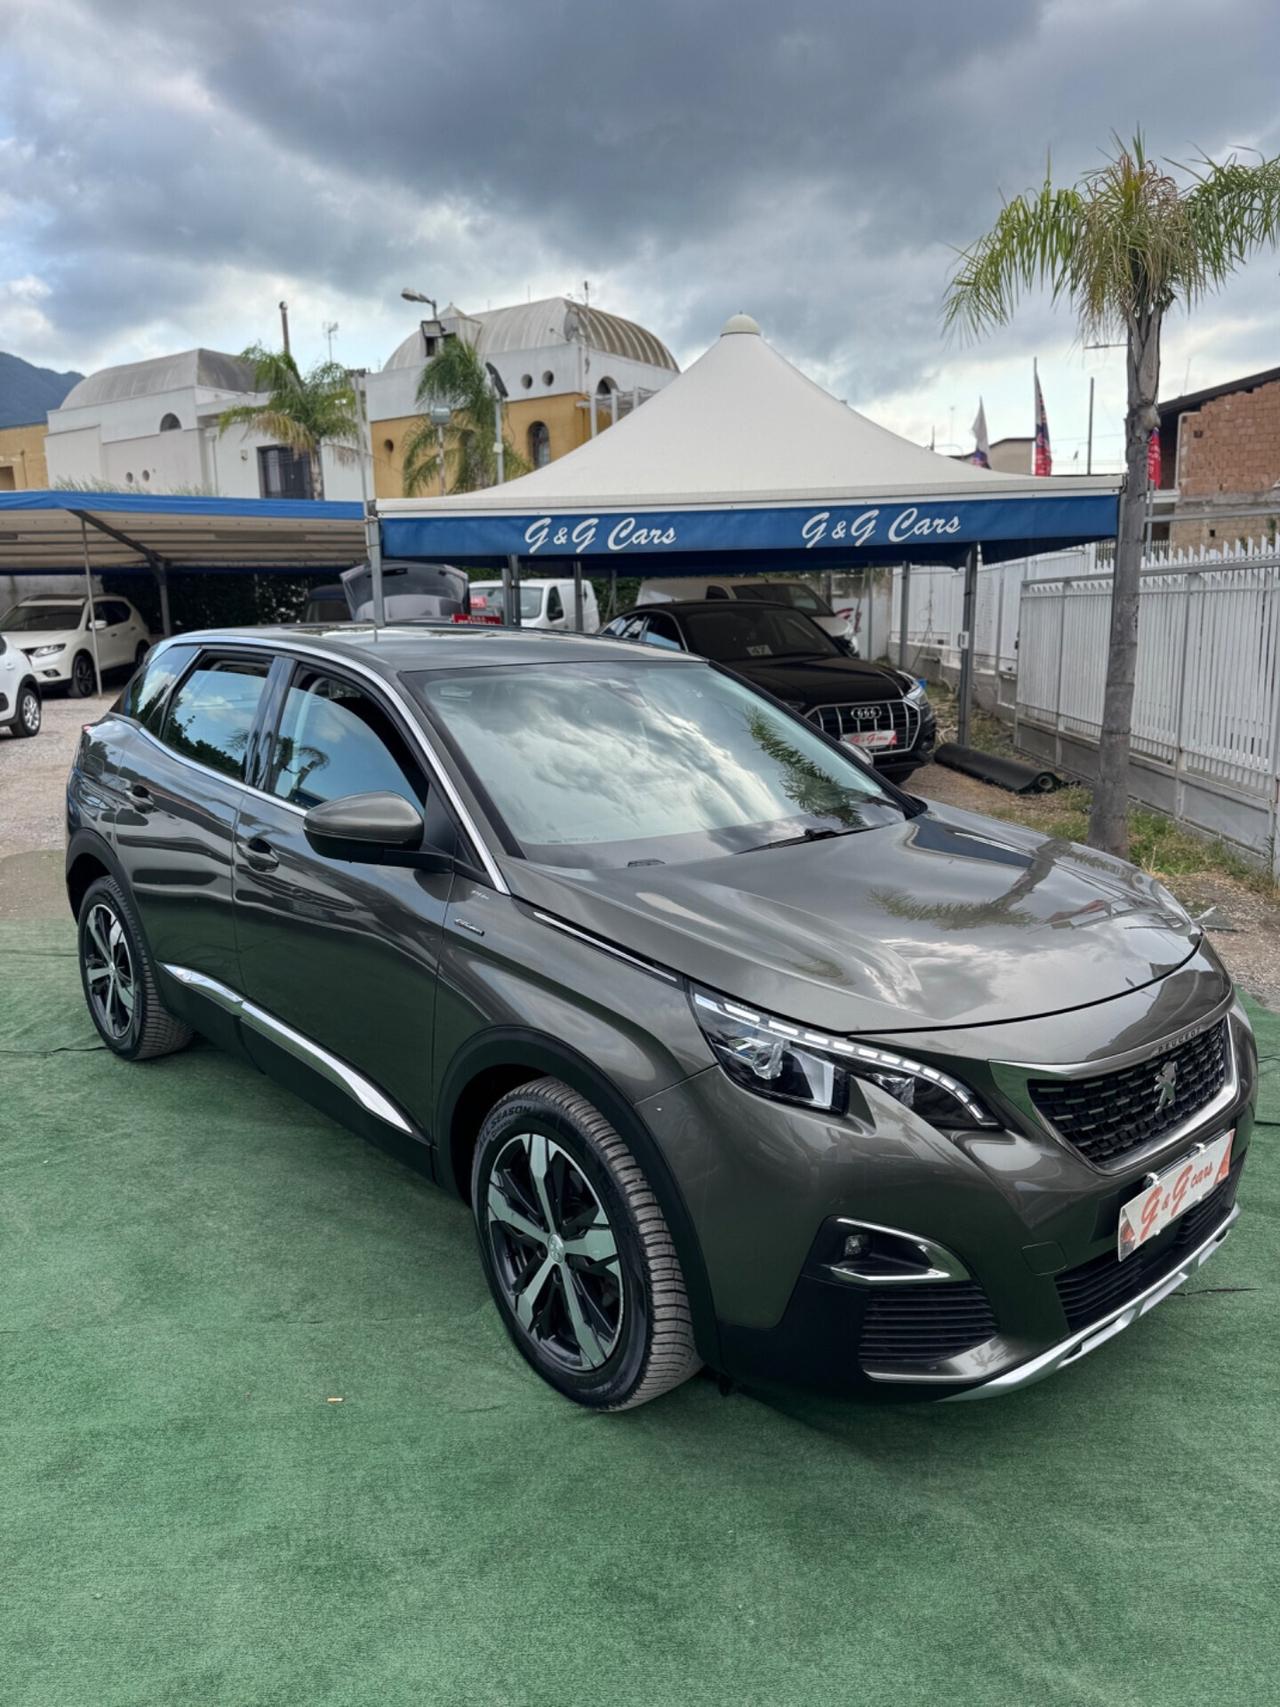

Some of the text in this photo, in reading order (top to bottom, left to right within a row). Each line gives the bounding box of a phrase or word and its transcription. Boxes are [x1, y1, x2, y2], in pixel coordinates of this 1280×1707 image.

[607, 517, 677, 551] Cars
[888, 507, 961, 542] Cars
[1157, 1026, 1201, 1054] PEUGEOT
